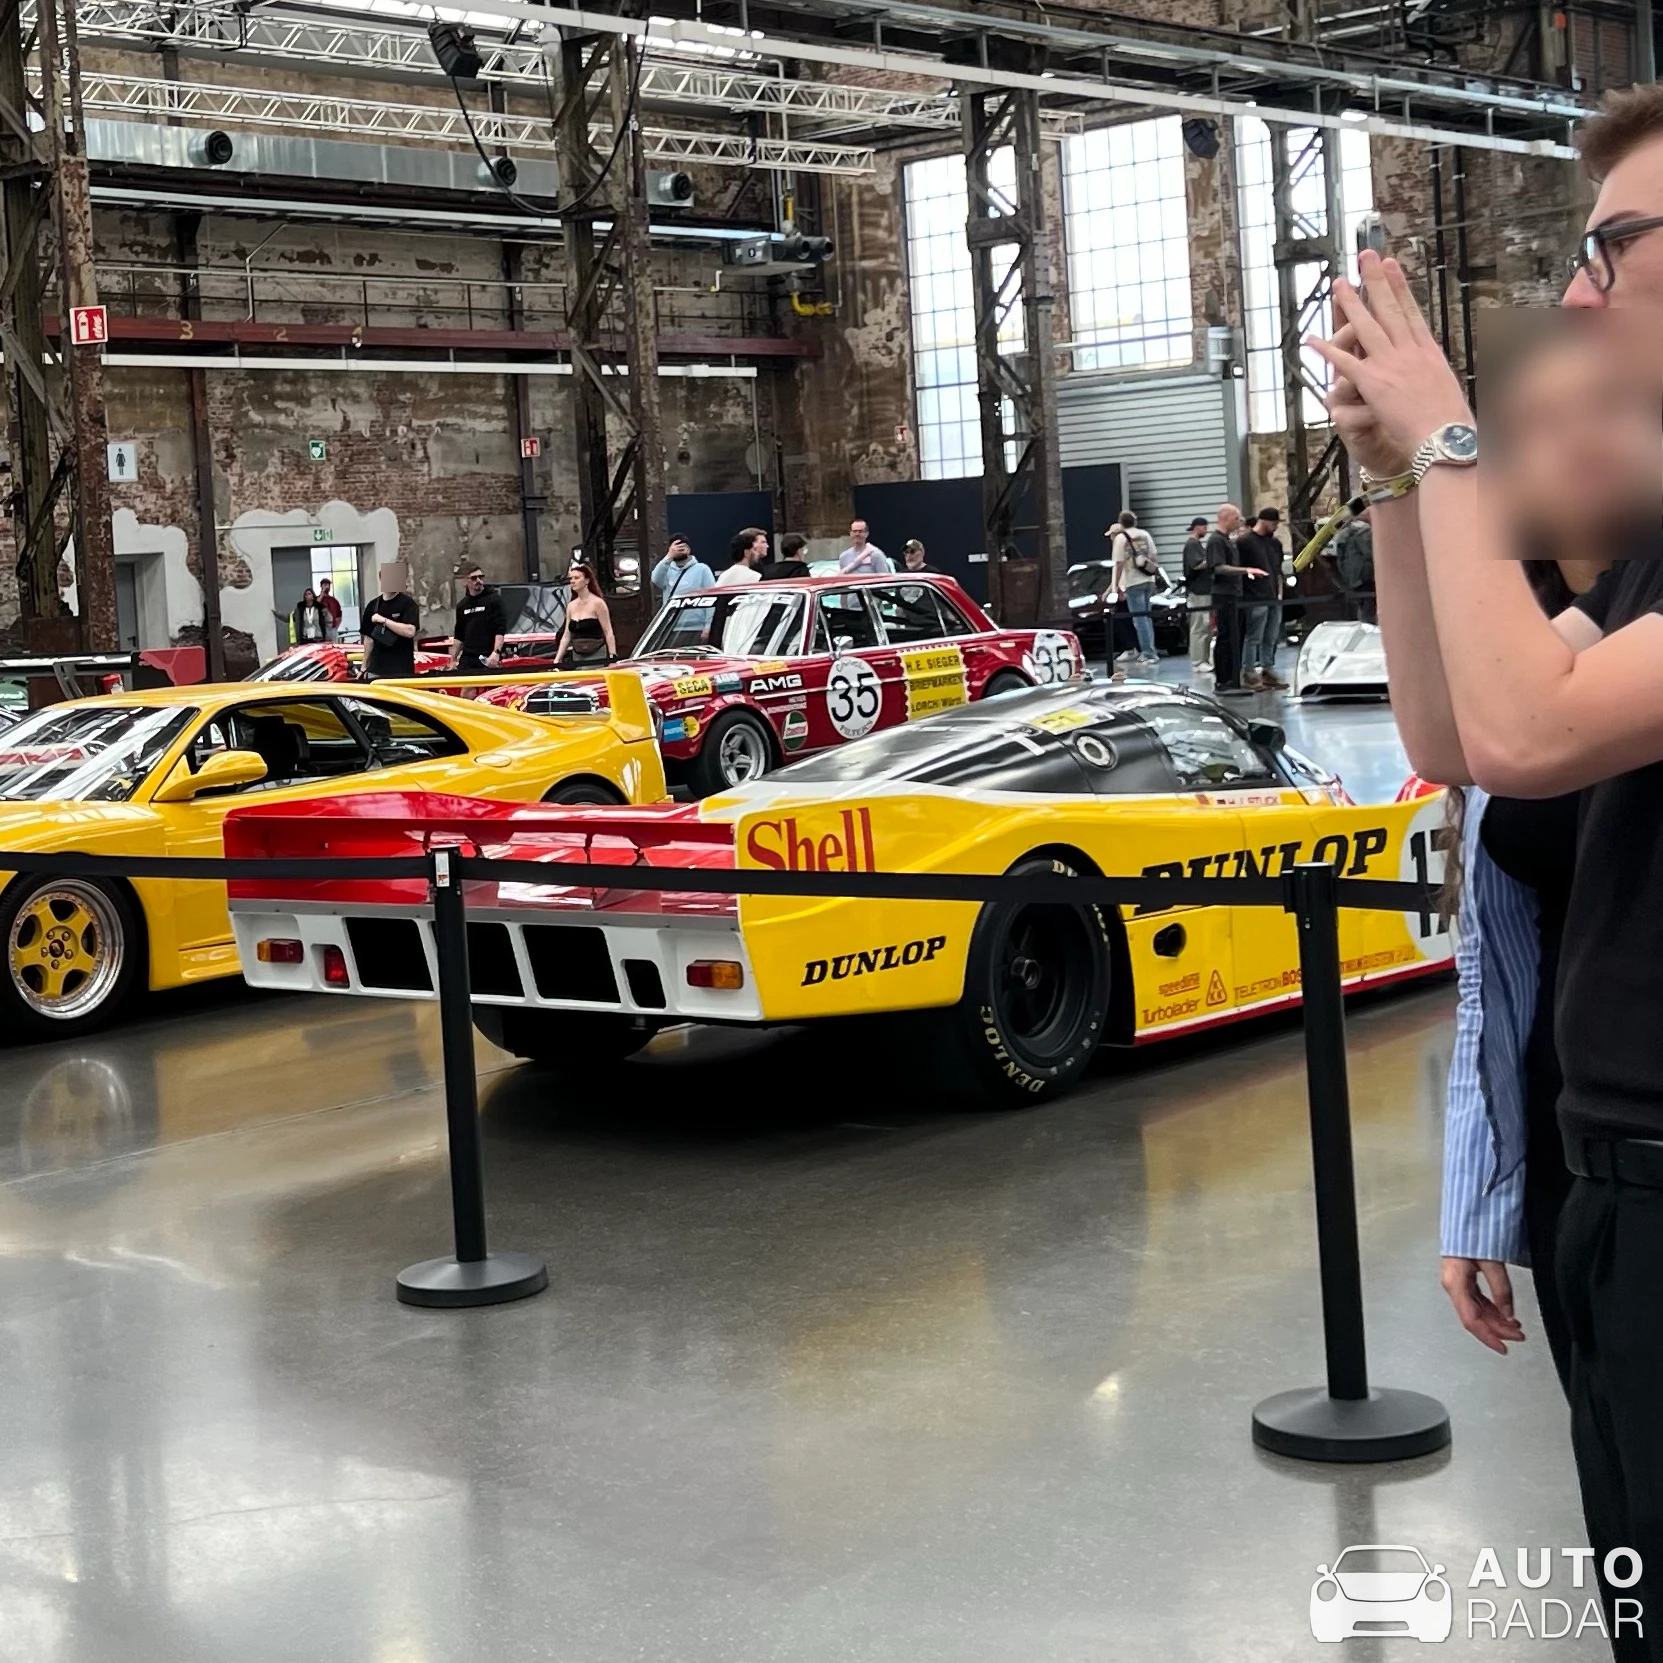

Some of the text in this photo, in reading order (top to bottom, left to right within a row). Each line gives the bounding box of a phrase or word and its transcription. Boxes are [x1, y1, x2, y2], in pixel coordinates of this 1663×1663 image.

[180, 320, 194, 340] 3
[666, 597, 718, 609] AMG
[926, 656, 960, 670] SIEGER
[1035, 645, 1072, 682] 35
[749, 674, 803, 694] AMG
[831, 672, 879, 722] 35
[747, 807, 877, 875] Shell
[800, 936, 946, 987] DUNLOP
[1282, 968, 1302, 987] BOS
